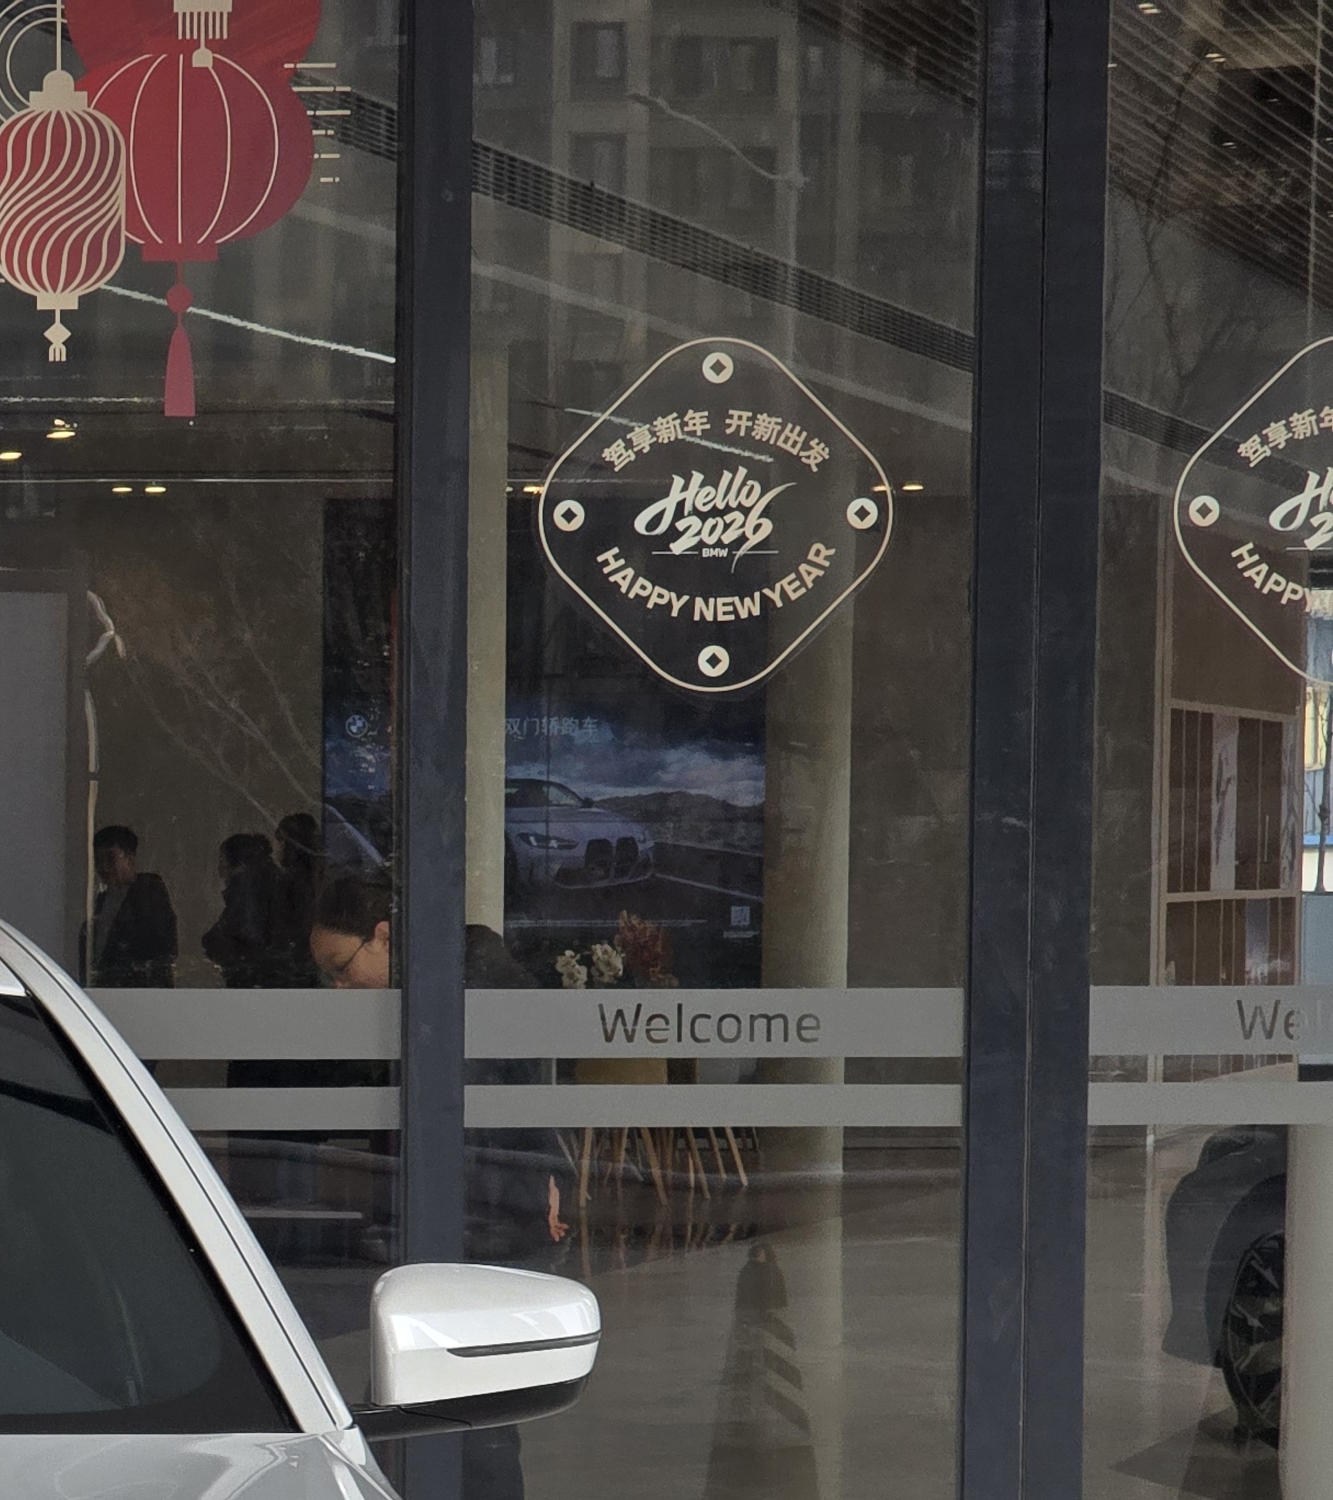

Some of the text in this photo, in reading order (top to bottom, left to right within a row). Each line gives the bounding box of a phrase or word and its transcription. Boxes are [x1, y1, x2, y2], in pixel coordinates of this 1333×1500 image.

[602, 409, 829, 472] 驾享新年 开新出发
[634, 466, 761, 535] Hello
[669, 482, 797, 573] 2026
[596, 542, 835, 621] HAPPY NEW YEAR
[702, 548, 728, 558] BMW
[598, 1003, 821, 1043] Welcome
